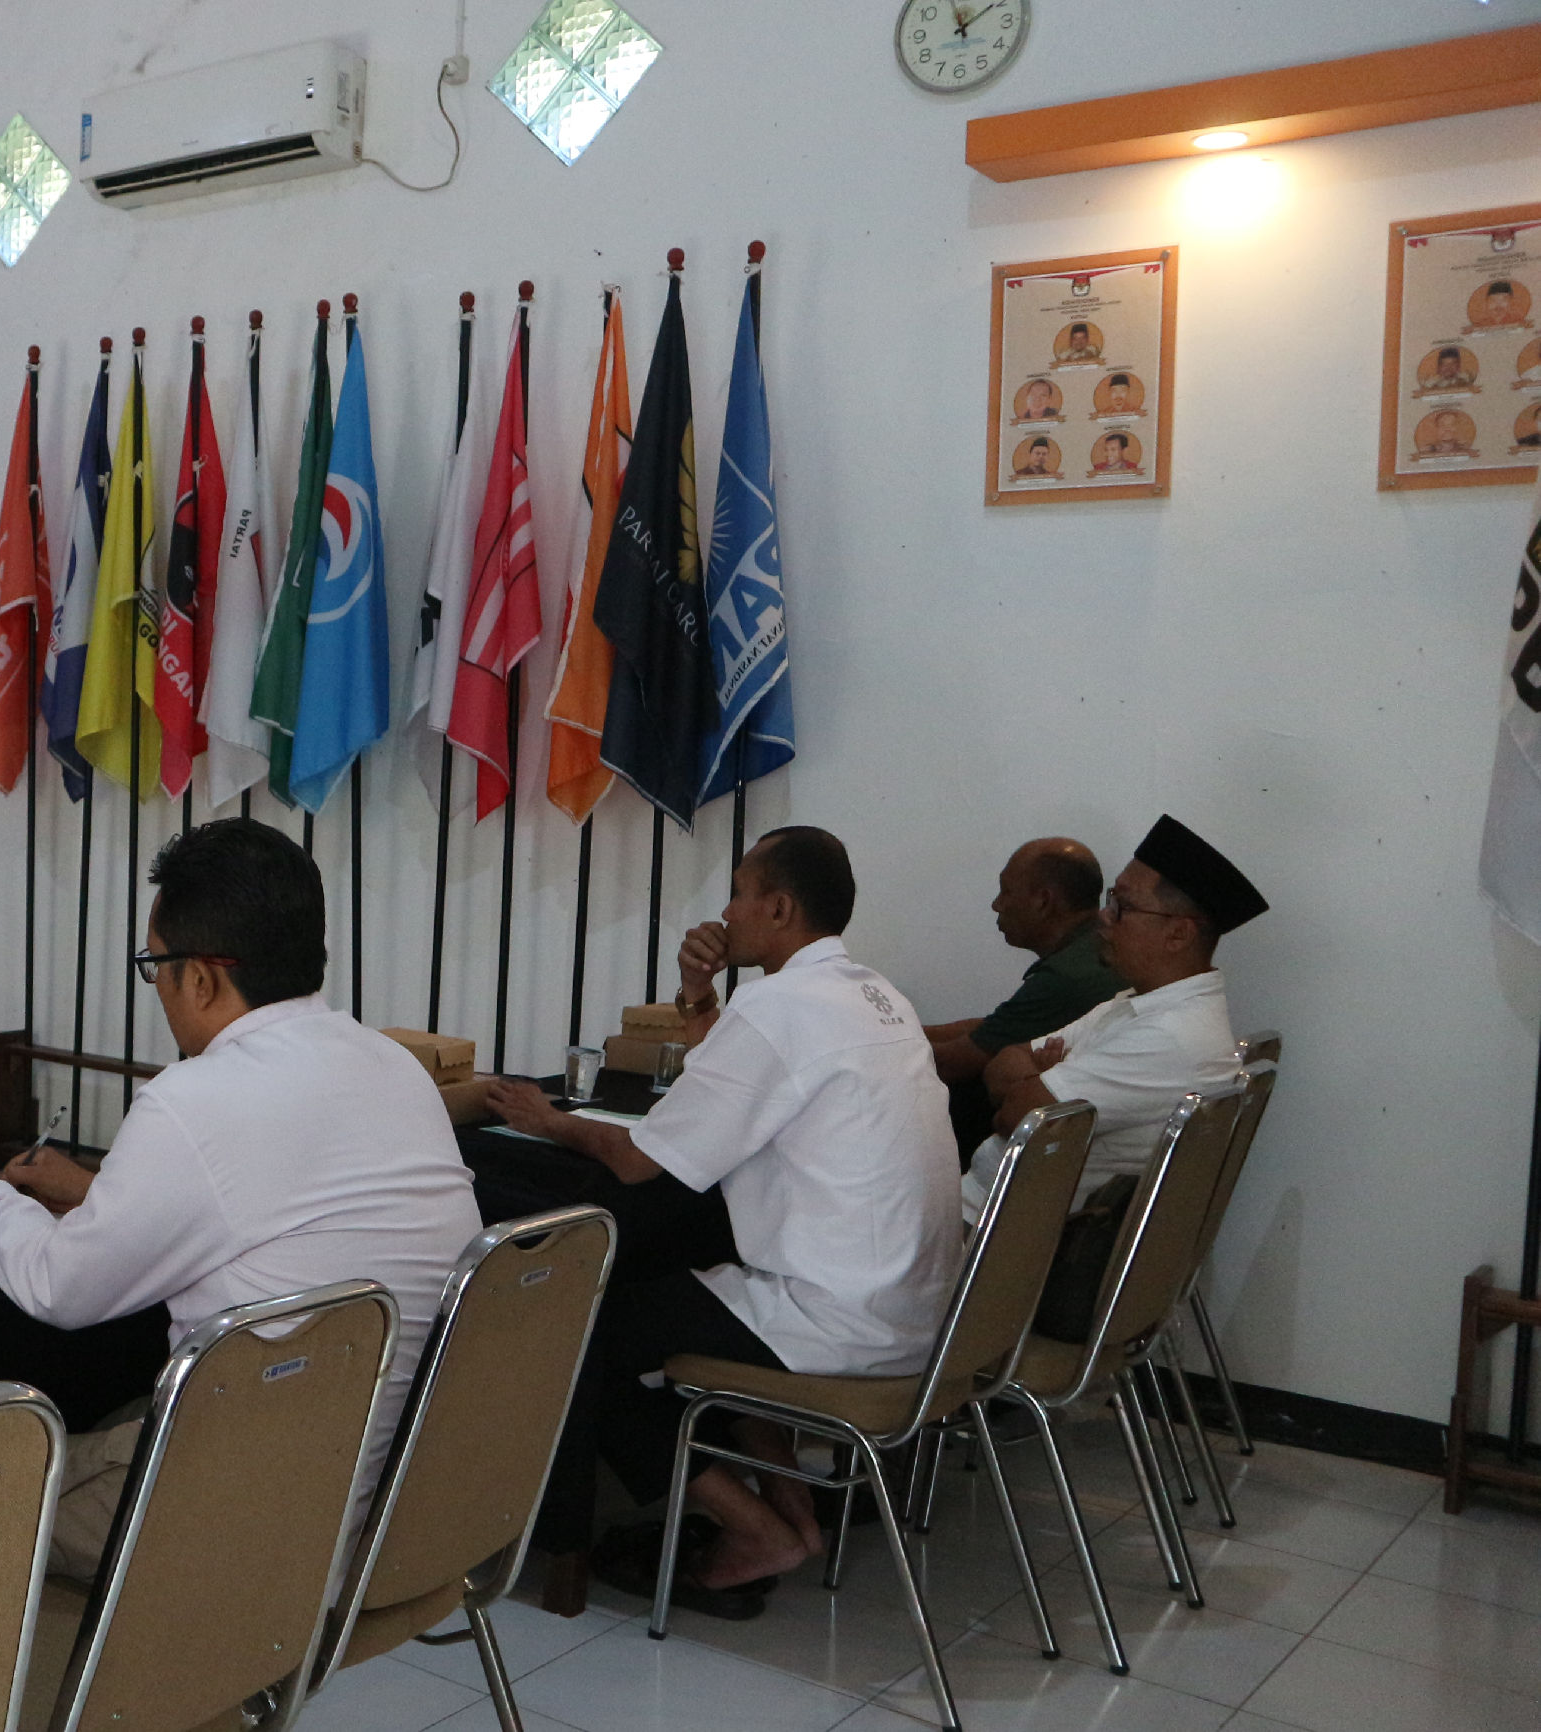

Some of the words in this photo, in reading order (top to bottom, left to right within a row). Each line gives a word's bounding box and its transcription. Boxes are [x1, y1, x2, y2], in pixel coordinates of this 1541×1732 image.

[921, 6, 938, 22] 10
[1000, 13, 1013, 29] 3
[913, 29, 926, 44] 9
[992, 36, 1005, 50] 4
[919, 48, 931, 63] 8
[976, 54, 988, 70] 5
[934, 61, 946, 76] 7
[953, 64, 966, 79] 6
[618, 505, 670, 585] PARAI
